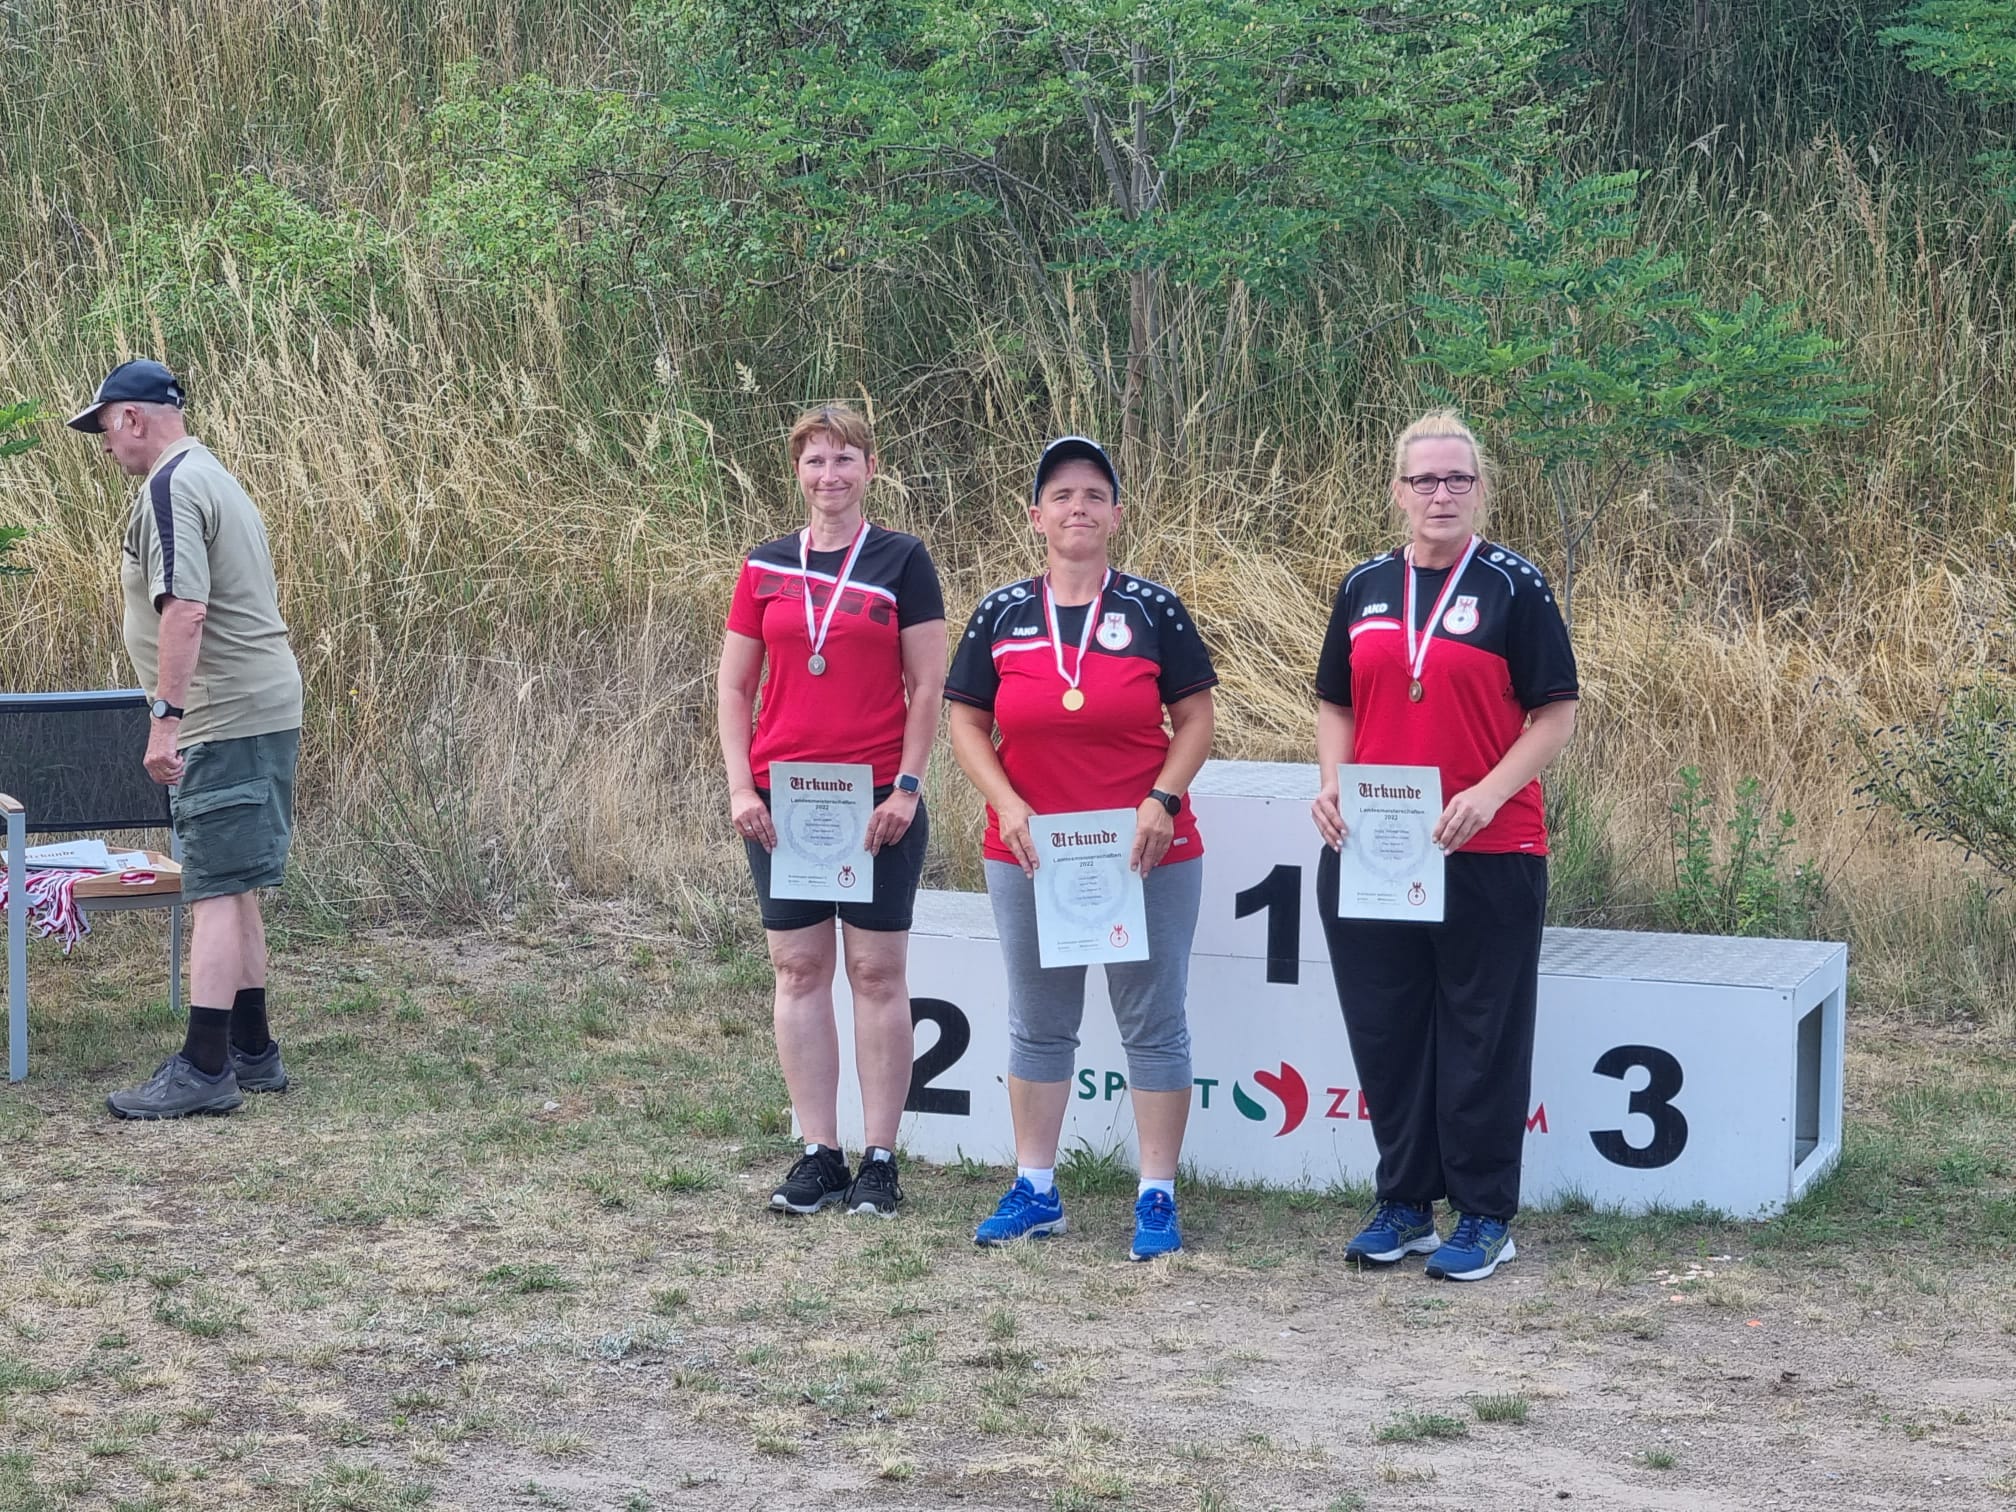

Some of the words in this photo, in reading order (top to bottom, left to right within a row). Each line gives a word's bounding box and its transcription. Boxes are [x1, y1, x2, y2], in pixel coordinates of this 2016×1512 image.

[1362, 603, 1388, 617] JAKO
[1012, 626, 1038, 636] JAKO
[790, 776, 854, 792] Urkunde
[1358, 782, 1422, 800] Urkunde
[1051, 830, 1118, 848] Urkunde
[1234, 864, 1302, 985] 1
[903, 998, 970, 1116] 2
[1078, 1069, 1219, 1109] SPT
[1590, 1044, 1689, 1169] 3
